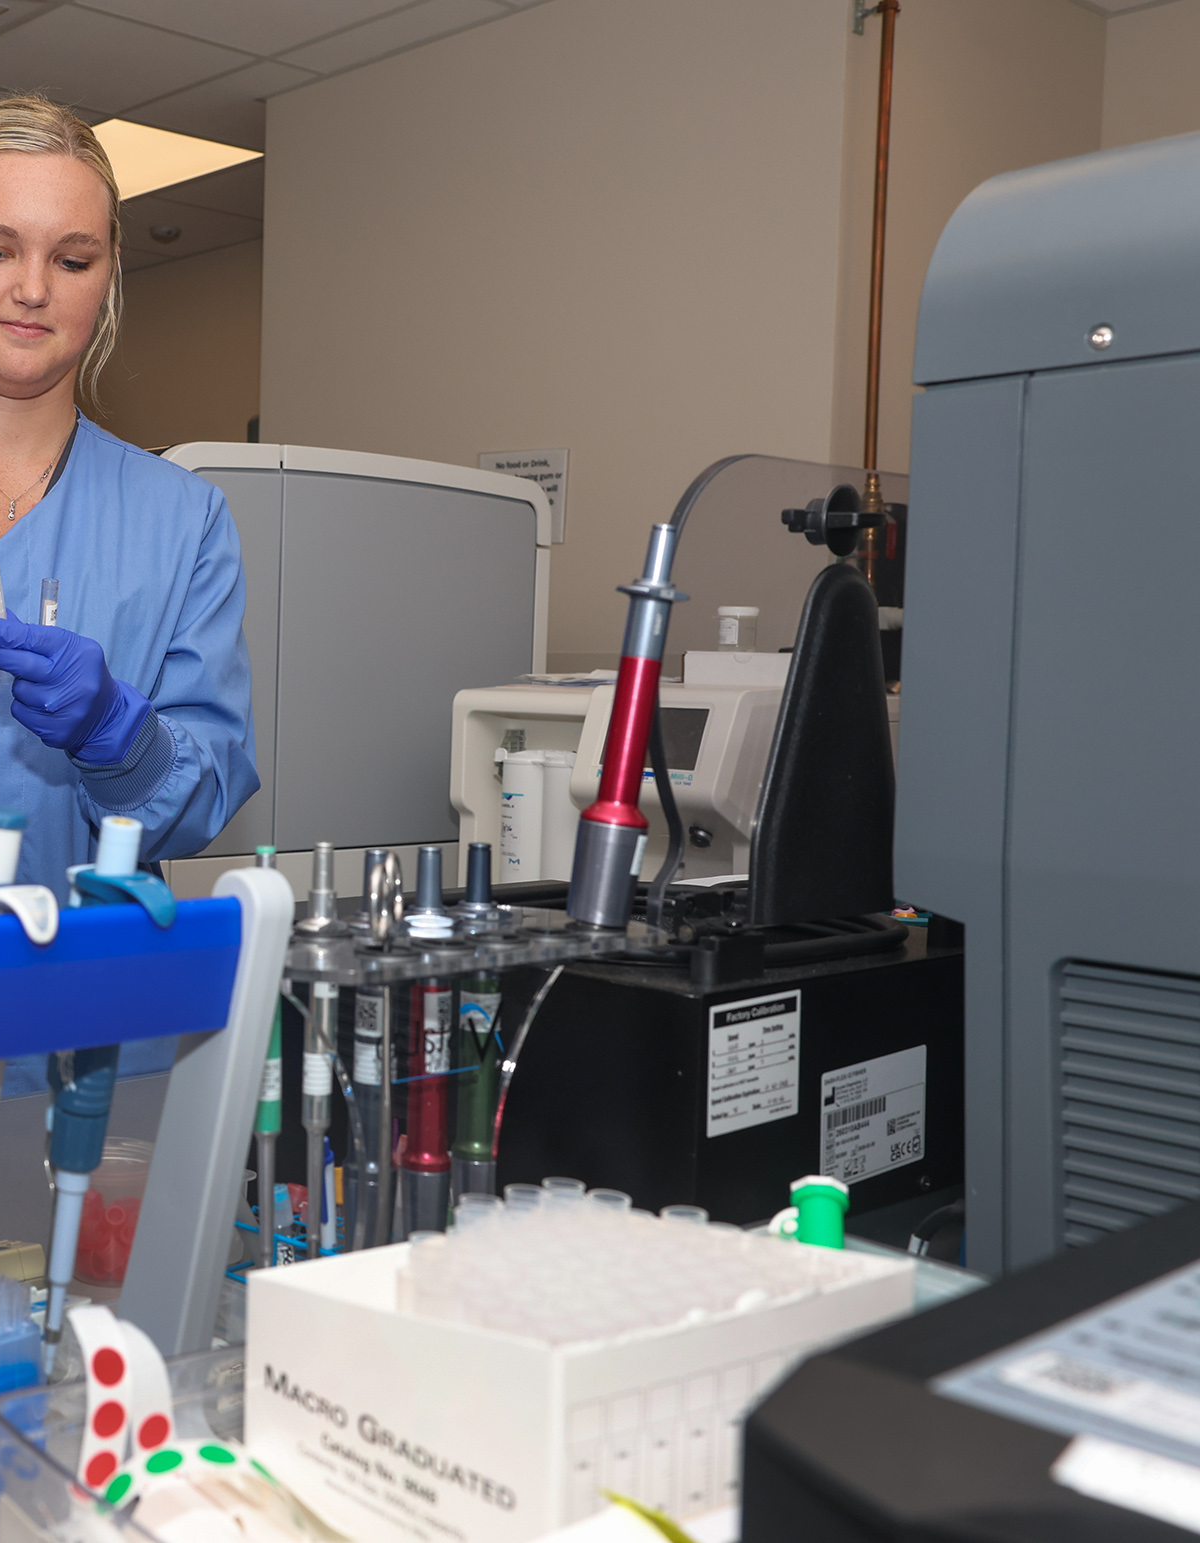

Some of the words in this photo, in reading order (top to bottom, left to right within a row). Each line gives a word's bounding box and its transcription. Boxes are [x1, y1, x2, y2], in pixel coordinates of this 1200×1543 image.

[531, 459, 550, 467] Drink,
[540, 473, 554, 481] gum
[546, 484, 558, 492] will
[726, 1010, 750, 1023] Factory
[751, 1003, 785, 1018] Calibration
